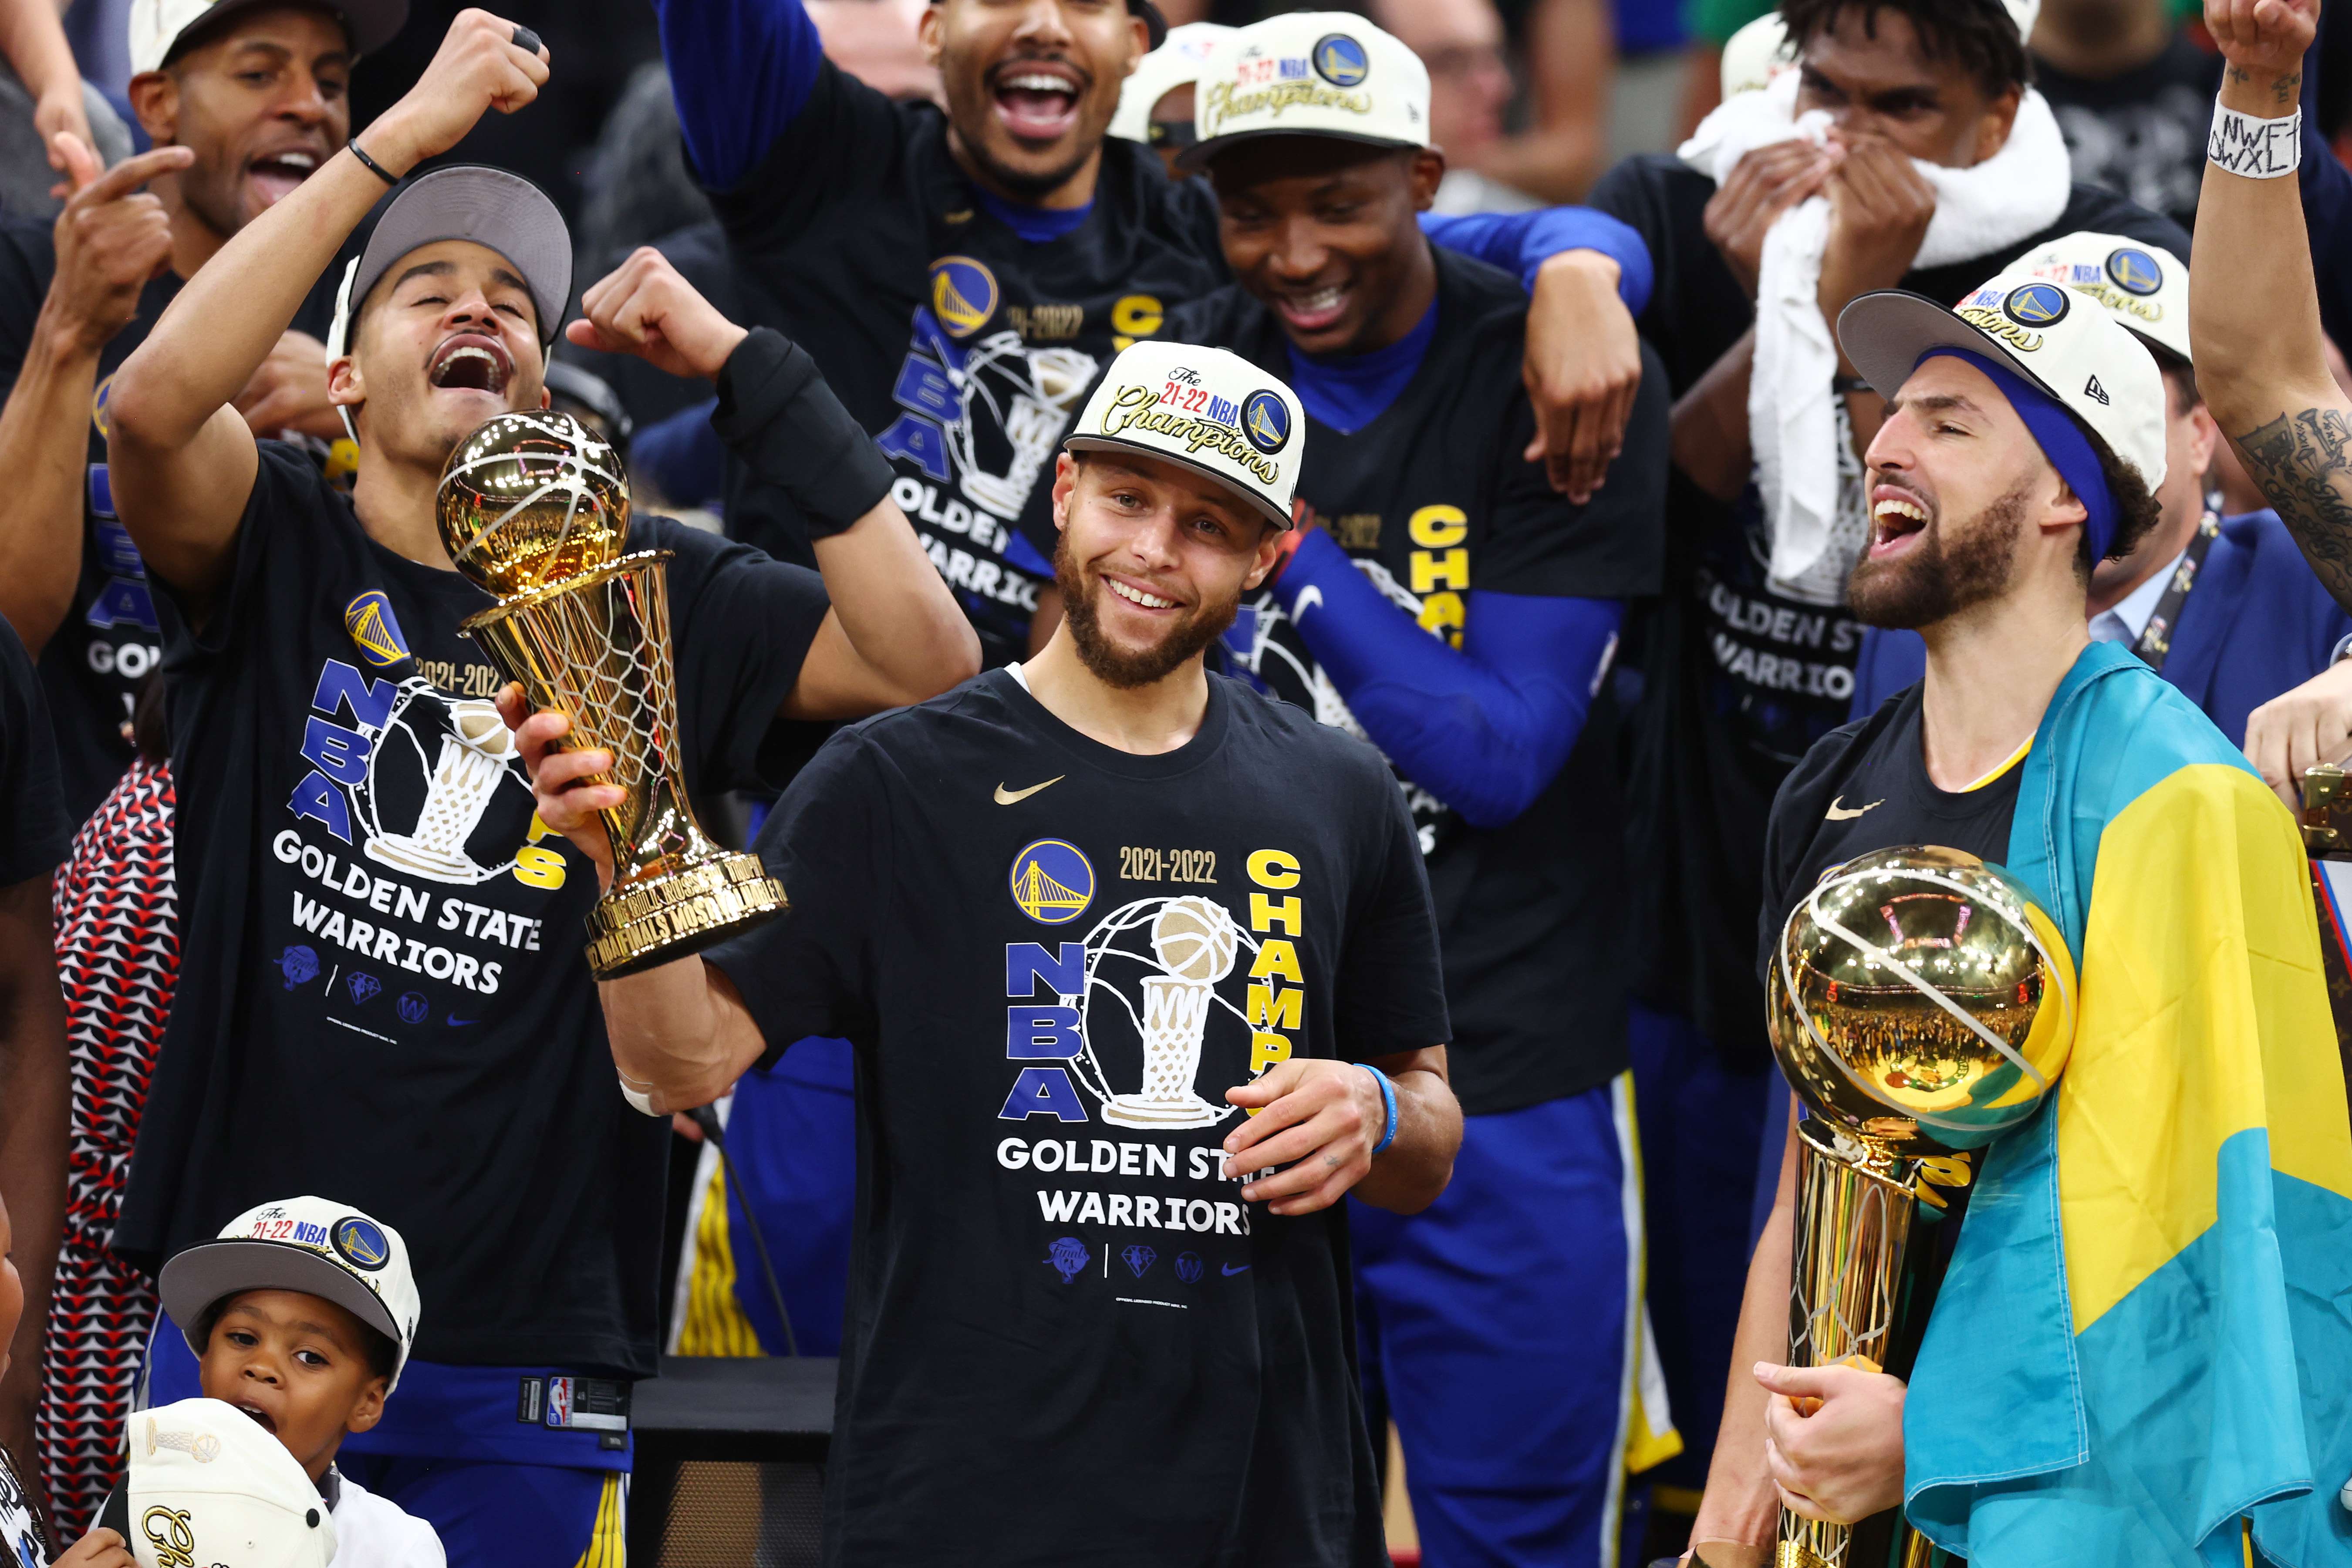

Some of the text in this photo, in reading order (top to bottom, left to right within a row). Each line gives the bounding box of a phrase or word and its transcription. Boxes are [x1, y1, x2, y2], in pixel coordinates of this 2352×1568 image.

[2071, 264, 2102, 282] NBA
[1972, 290, 2005, 307] NBA
[1168, 367, 1202, 386] The
[1159, 382, 1239, 427] 21-22 NBA
[1100, 385, 1279, 485] Champions
[1408, 503, 1470, 652] CHA
[415, 657, 504, 698] 2021-202
[1709, 630, 1856, 700] WARRIO
[286, 658, 400, 846] NBA
[1119, 846, 1218, 884] 2021-2022
[273, 829, 431, 924] GOLDEN
[437, 897, 543, 951] STATE
[292, 890, 503, 995] WARRIORS
[615, 915, 672, 958] FINALS
[670, 897, 723, 934] MOST
[1246, 849, 1305, 1119] CHAMP
[997, 941, 1090, 1123] NBA
[997, 1137, 1177, 1178] GOLDEN
[251, 1221, 327, 1246] 21-22 NBA
[256, 1207, 287, 1221] The
[1036, 1190, 1251, 1236] WARRIORS
